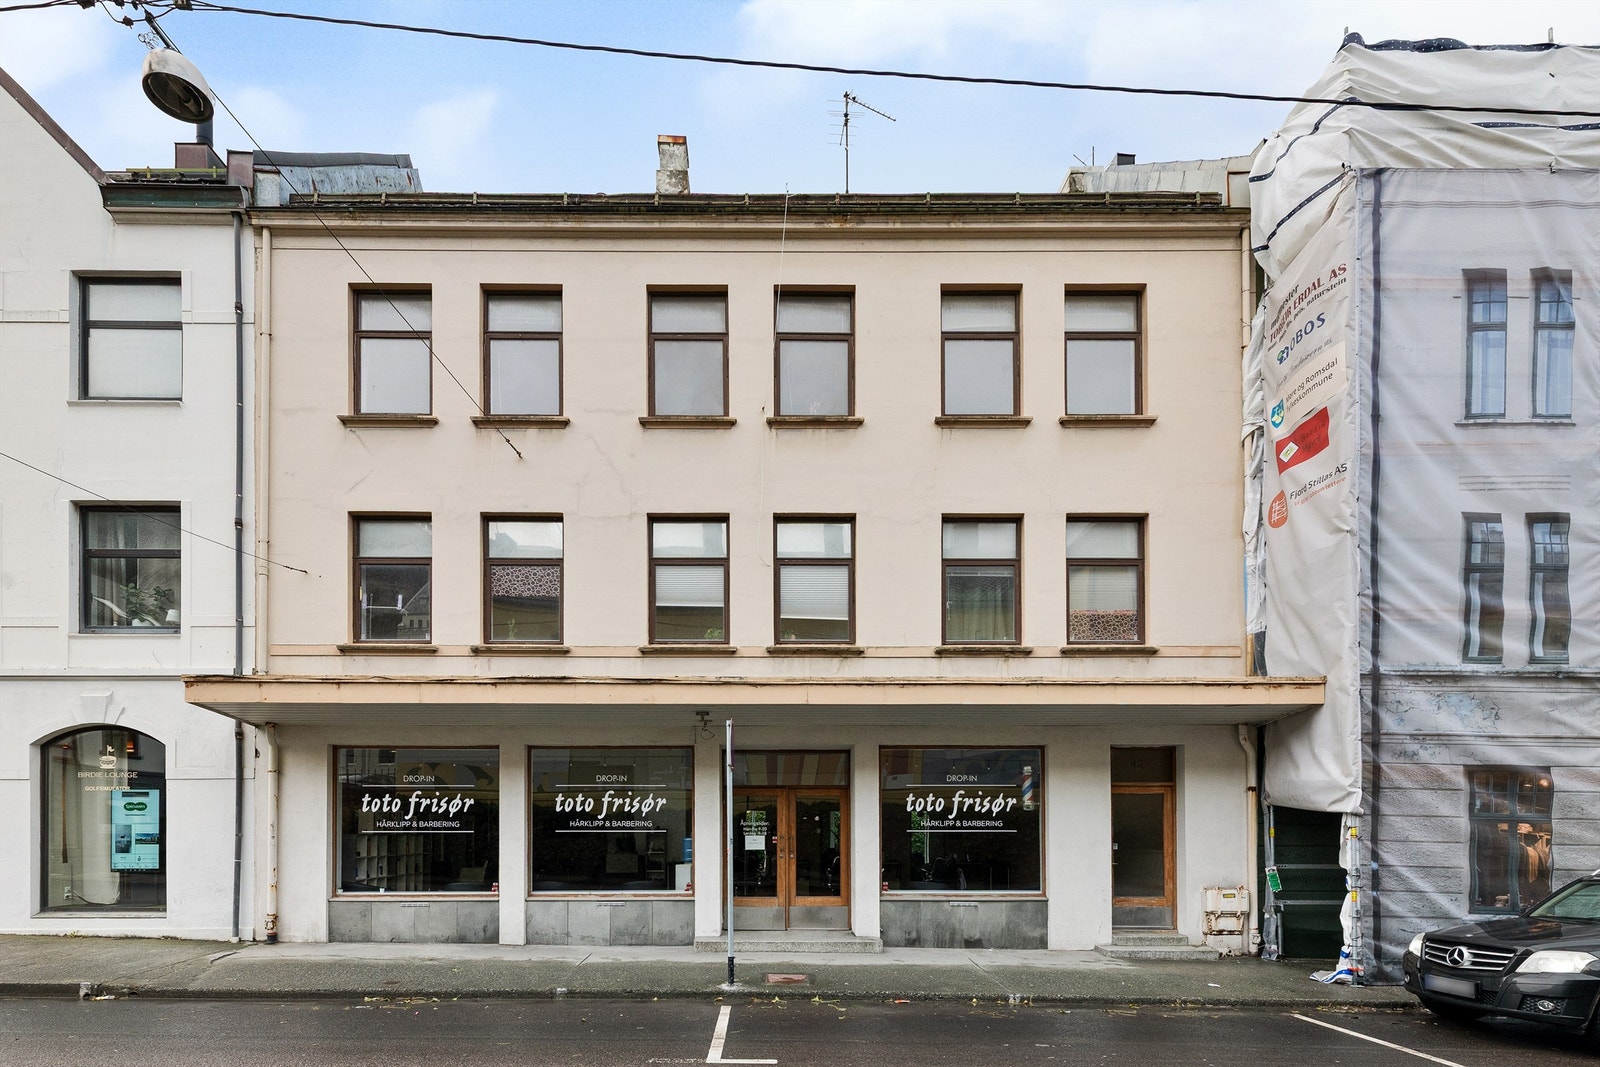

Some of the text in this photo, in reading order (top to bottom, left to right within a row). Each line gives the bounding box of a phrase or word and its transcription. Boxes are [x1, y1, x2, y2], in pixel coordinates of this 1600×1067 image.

[1293, 278, 1325, 311] ERDAL
[1329, 263, 1347, 282] AS
[1306, 277, 1347, 307] naturstein
[1290, 312, 1326, 352] OBOS
[1305, 357, 1338, 385] Romsdal
[1290, 463, 1348, 499] Fjord Stillas AS
[77, 771, 138, 779] BIRDIE LOUNGE
[362, 790, 474, 819] toto frisør
[555, 790, 667, 819] toto frisør
[906, 790, 1017, 819] toto frisør
[376, 819, 411, 827] HÅRKLIPP
[570, 819, 604, 827] HÅRKLIPP
[920, 819, 955, 827] HÅRKLIPP
